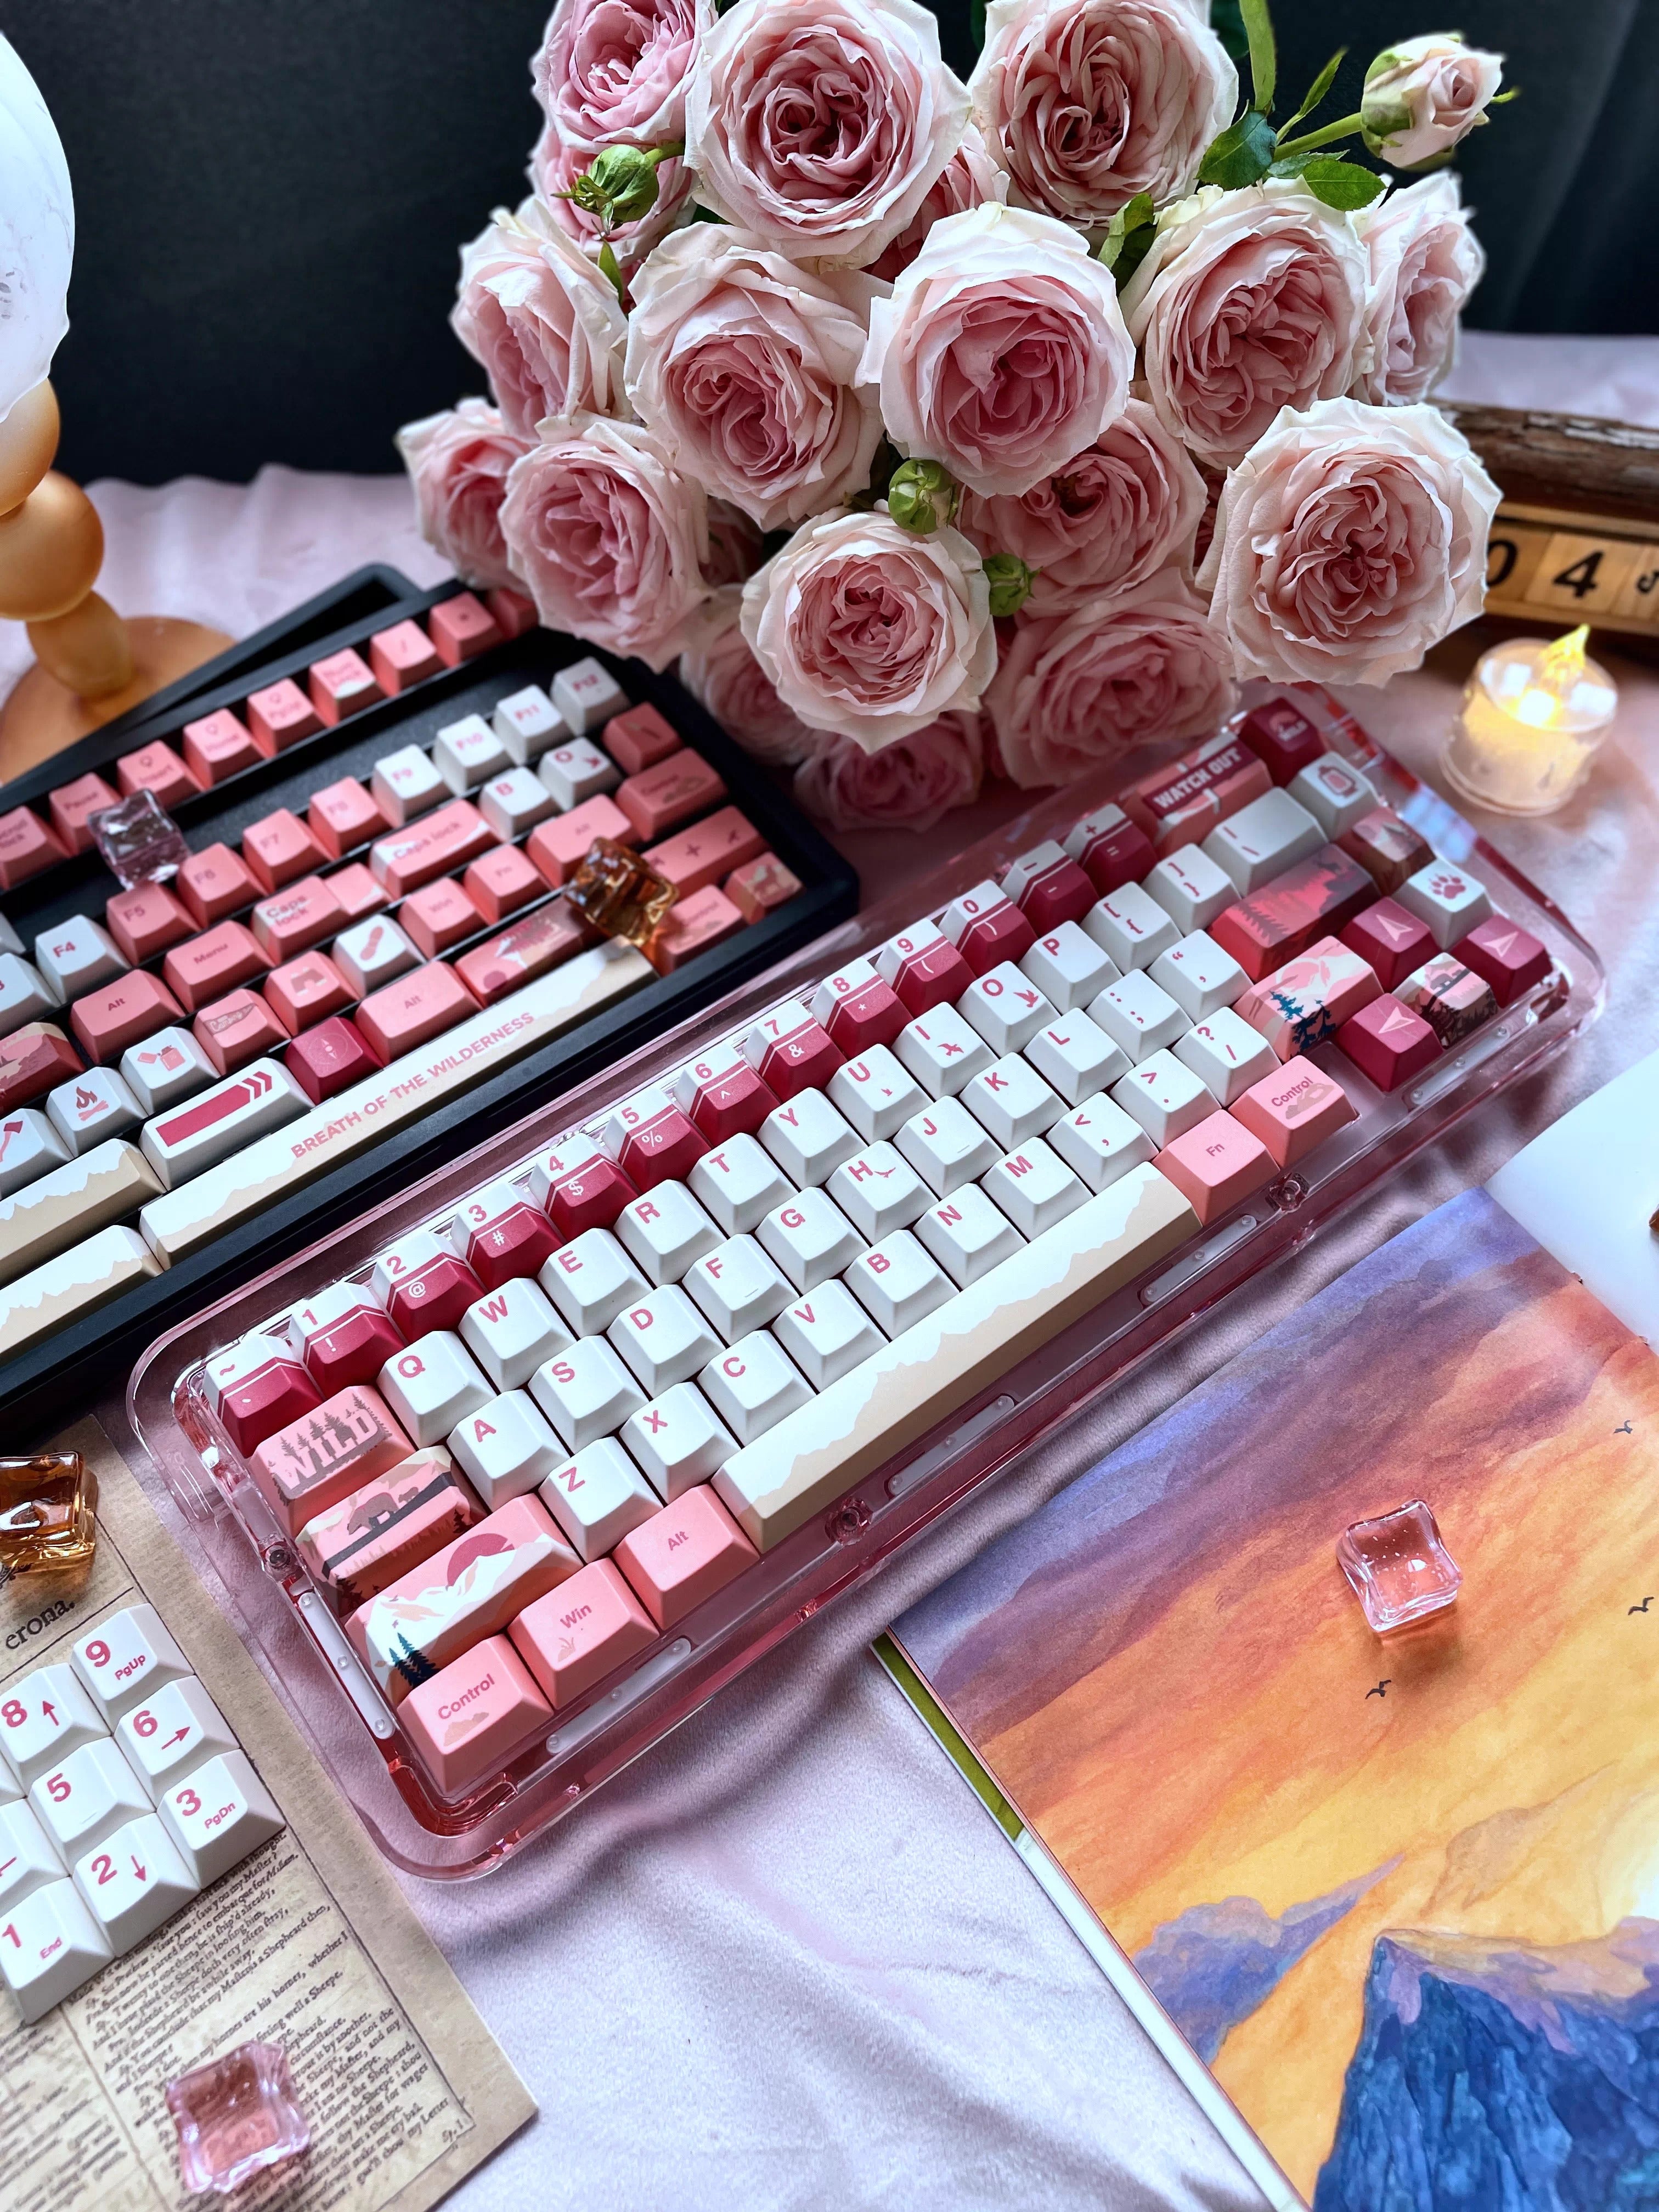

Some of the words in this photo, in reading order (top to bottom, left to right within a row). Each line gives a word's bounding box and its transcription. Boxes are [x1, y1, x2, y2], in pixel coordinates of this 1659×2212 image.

[1554, 550, 1604, 597] 4
[1153, 768, 1211, 809] WATCH
[1207, 746, 1243, 775] OUT
[123, 904, 145, 923] F5
[963, 899, 979, 913] 0
[53, 941, 76, 958] F4
[193, 943, 228, 965] Menu
[897, 938, 914, 952] 9
[1043, 938, 1060, 956] P
[832, 977, 850, 992] 8
[981, 979, 1003, 996] O
[108, 998, 125, 1012] Alt
[404, 995, 422, 1011] Alt
[764, 1019, 780, 1035] 7
[915, 1025, 930, 1040] I
[1047, 1031, 1070, 1045] L
[695, 1063, 713, 1079] 6
[848, 1062, 871, 1082] U
[291, 1111, 363, 1159] BREATH
[363, 1094, 388, 1116] OF
[390, 1073, 427, 1099] THE
[426, 1012, 535, 1079] WILDERNESS
[984, 1073, 1008, 1091] K
[1271, 1076, 1314, 1108] Control
[621, 1107, 639, 1124] 5
[778, 1108, 799, 1126] Y
[923, 1118, 938, 1136] J
[1206, 1142, 1225, 1156] Fn
[549, 1155, 564, 1172] 4
[709, 1153, 730, 1173] T
[848, 1160, 873, 1181] H
[1005, 1155, 1033, 1177] M
[469, 1204, 487, 1222] 3
[635, 1201, 661, 1223] R
[780, 1208, 805, 1228] G
[937, 1205, 962, 1226] N
[386, 1256, 407, 1275] 2
[558, 1250, 583, 1273] E
[706, 1257, 723, 1279] F
[867, 1253, 890, 1273] B
[302, 1309, 318, 1325] 1
[478, 1295, 508, 1323] W
[629, 1308, 653, 1330] D
[794, 1304, 815, 1323] V
[398, 1355, 426, 1378] Q
[551, 1361, 575, 1383] S
[723, 1357, 746, 1378] C
[474, 1419, 496, 1442] A
[643, 1410, 668, 1434] X
[274, 1408, 379, 1489] WILD
[558, 1466, 585, 1492] Z
[667, 1530, 689, 1551] Alt
[5, 1600, 76, 1650] erona.
[560, 1604, 592, 1629] Win
[86, 1640, 110, 1667] 9
[114, 1655, 146, 1680] PgUp
[437, 1673, 495, 1720] Control
[1, 1700, 27, 1728] 8
[133, 1710, 158, 1737] 6
[47, 1774, 71, 1802] 5
[176, 1789, 201, 1816] 3
[204, 1802, 236, 1830] PgDn
[91, 1854, 117, 1885] 2
[3, 1924, 21, 1948] 1
[263, 1917, 307, 1959] Shepheard
[40, 1937, 63, 1960] End
[222, 1943, 241, 1960] very
[308, 1937, 342, 1967] whether
[284, 1999, 304, 2019] well
